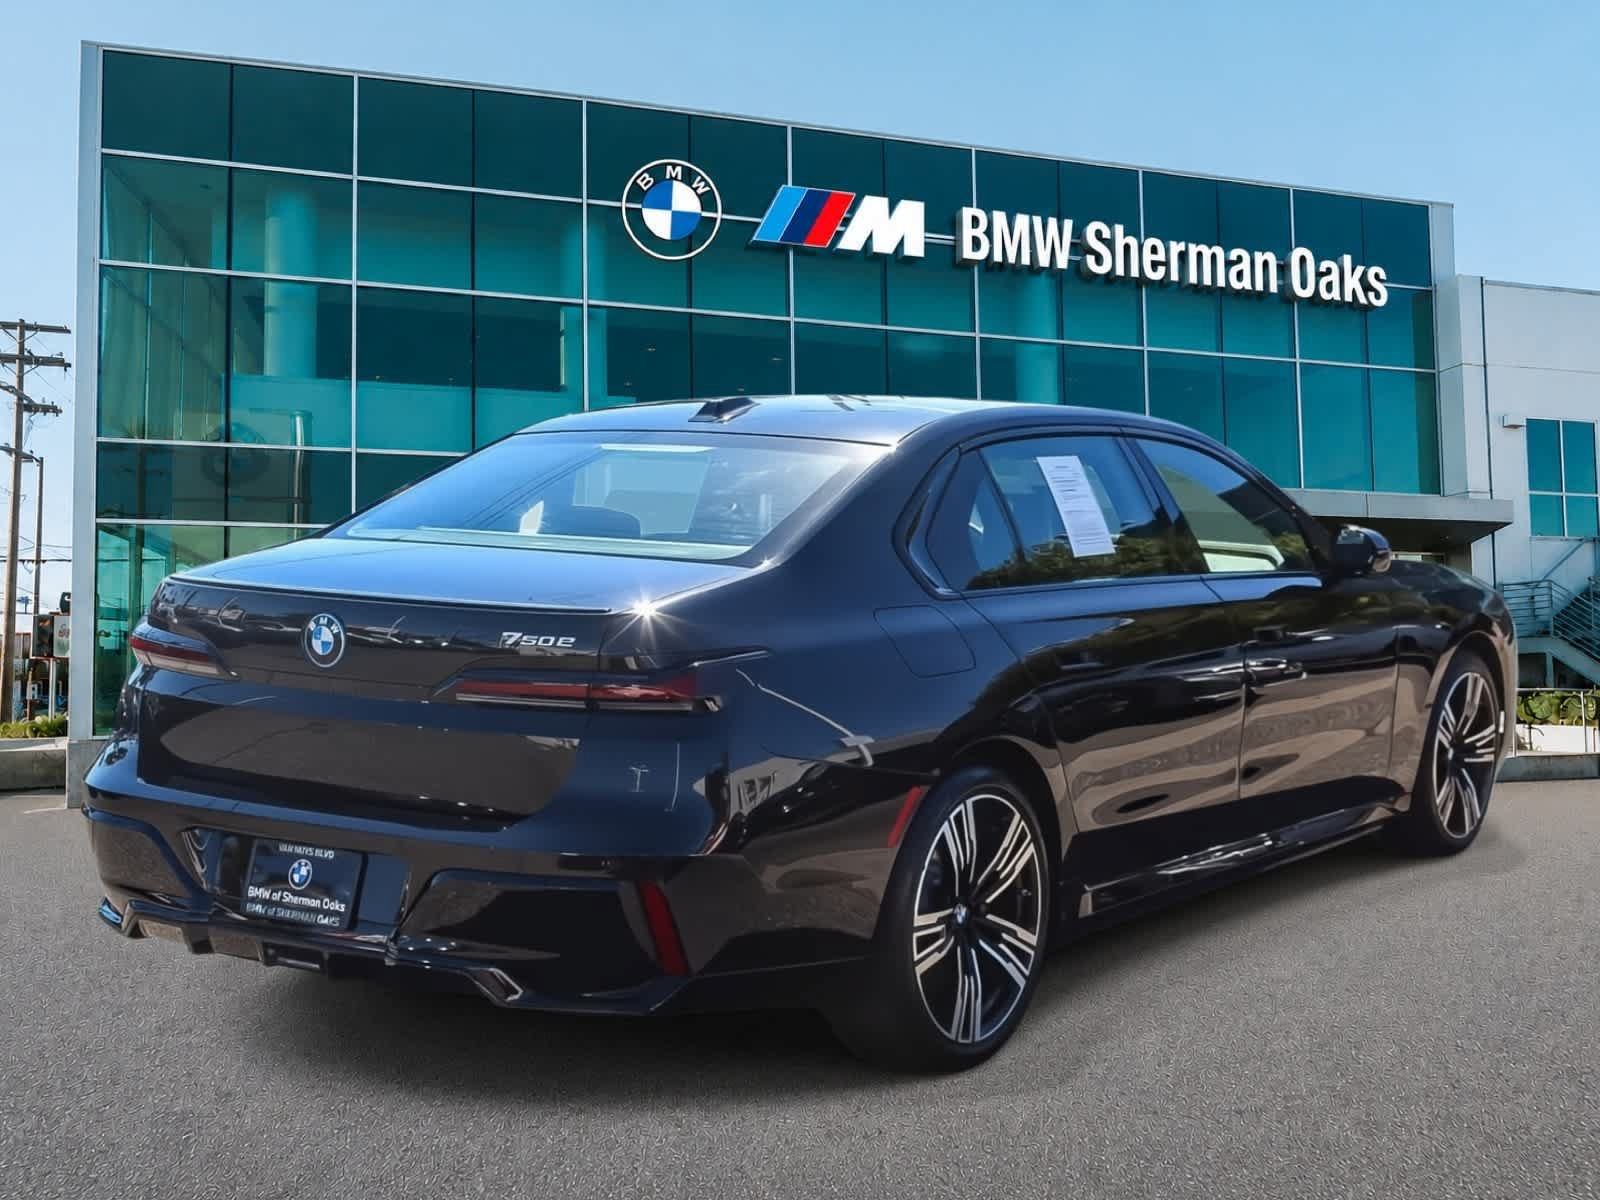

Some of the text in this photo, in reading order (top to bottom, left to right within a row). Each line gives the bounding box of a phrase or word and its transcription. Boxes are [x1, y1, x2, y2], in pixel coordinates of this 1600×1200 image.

[636, 165, 711, 195] BMW
[835, 195, 925, 258] M
[959, 206, 1388, 309] BMW Sherman Oaks
[247, 886, 346, 912] BMW of Sherman Oaks
